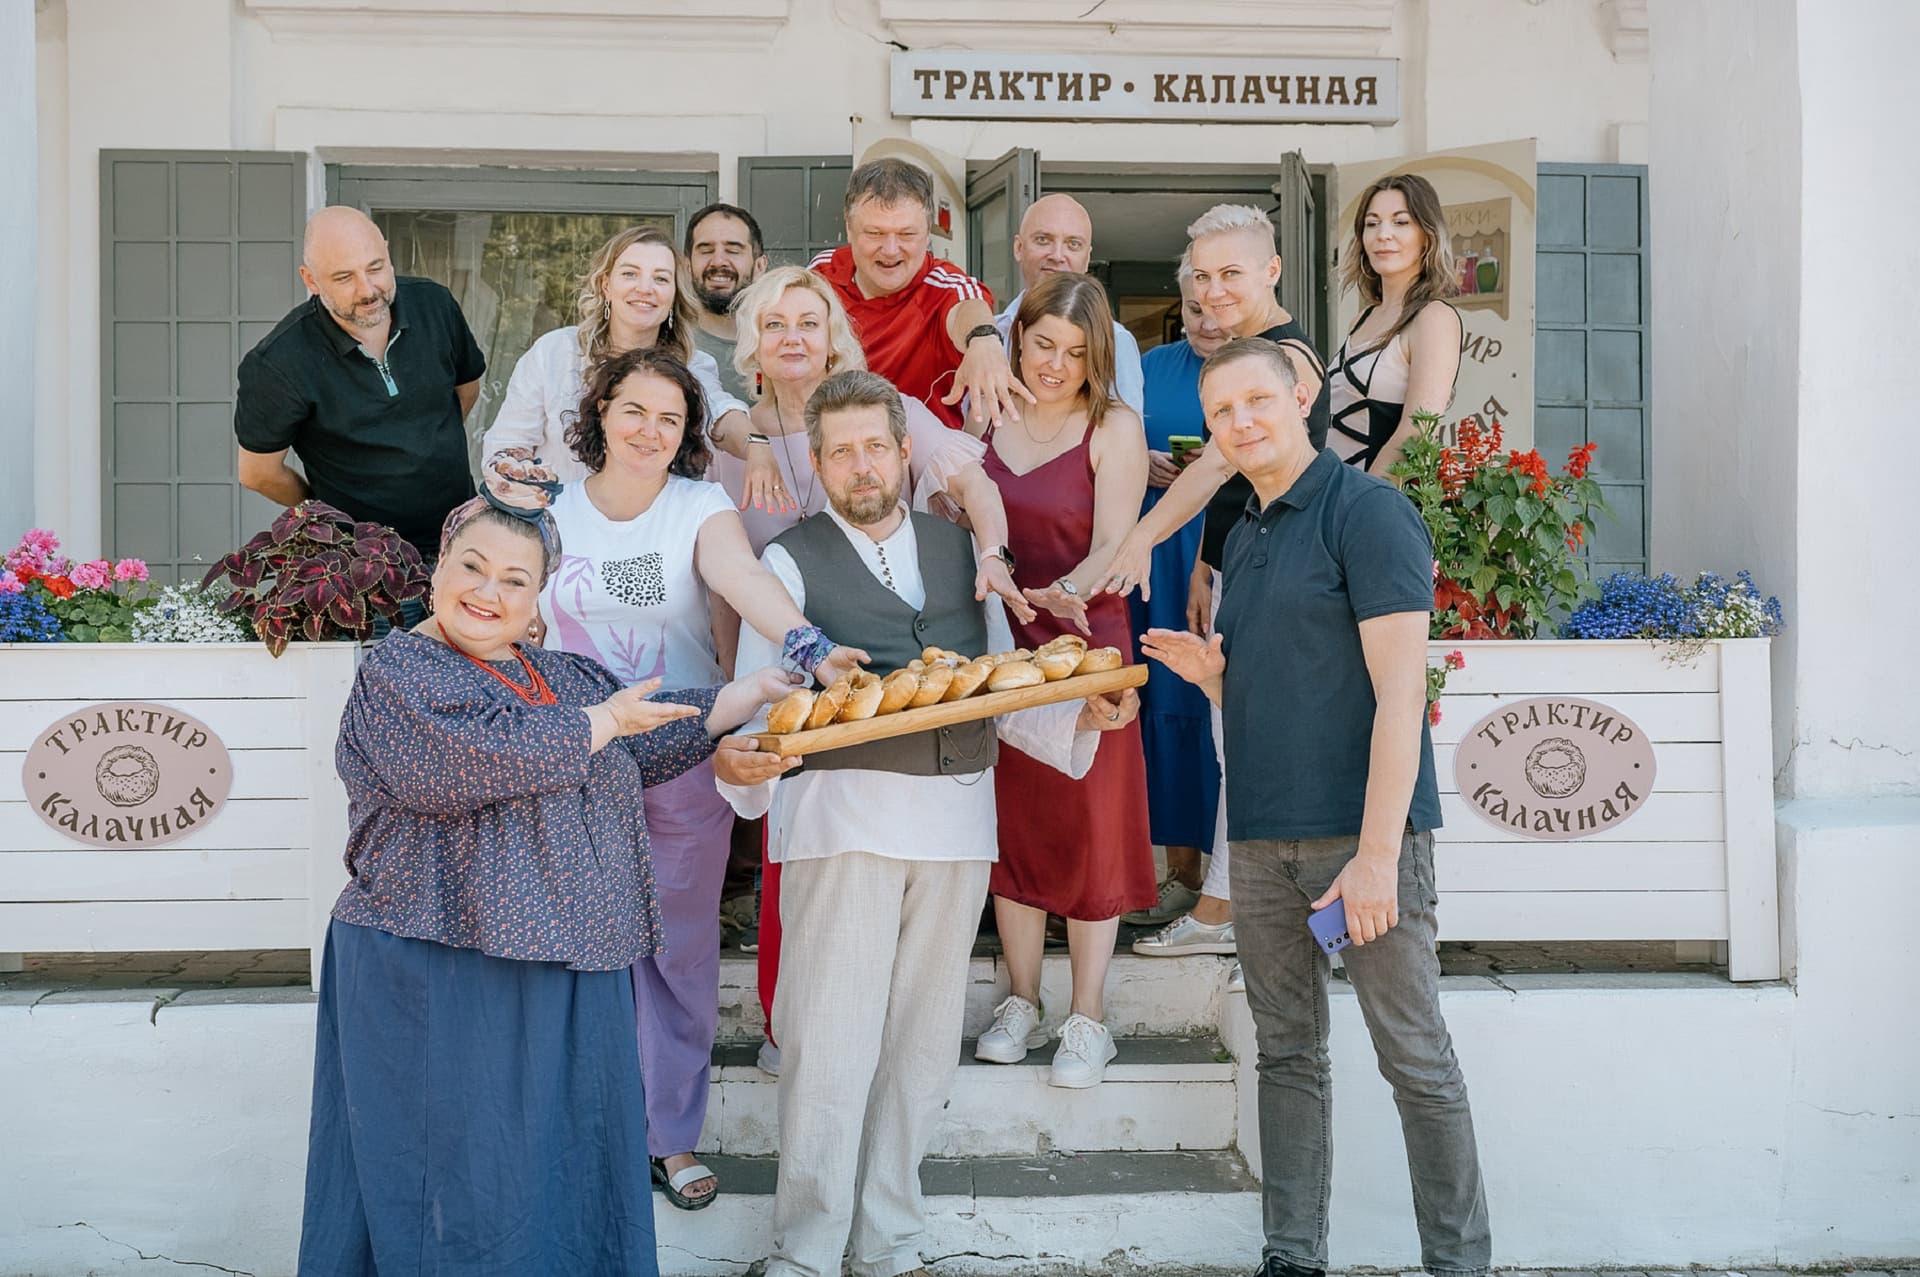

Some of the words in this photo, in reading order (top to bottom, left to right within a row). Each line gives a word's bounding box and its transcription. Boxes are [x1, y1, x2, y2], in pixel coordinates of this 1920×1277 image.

[913, 69, 1112, 101] ТРАКТИР
[1153, 74, 1378, 105] КАЛАЧНАЯ
[45, 708, 208, 755] ТРАКТИР
[1477, 703, 1633, 748] ТРАКТИР
